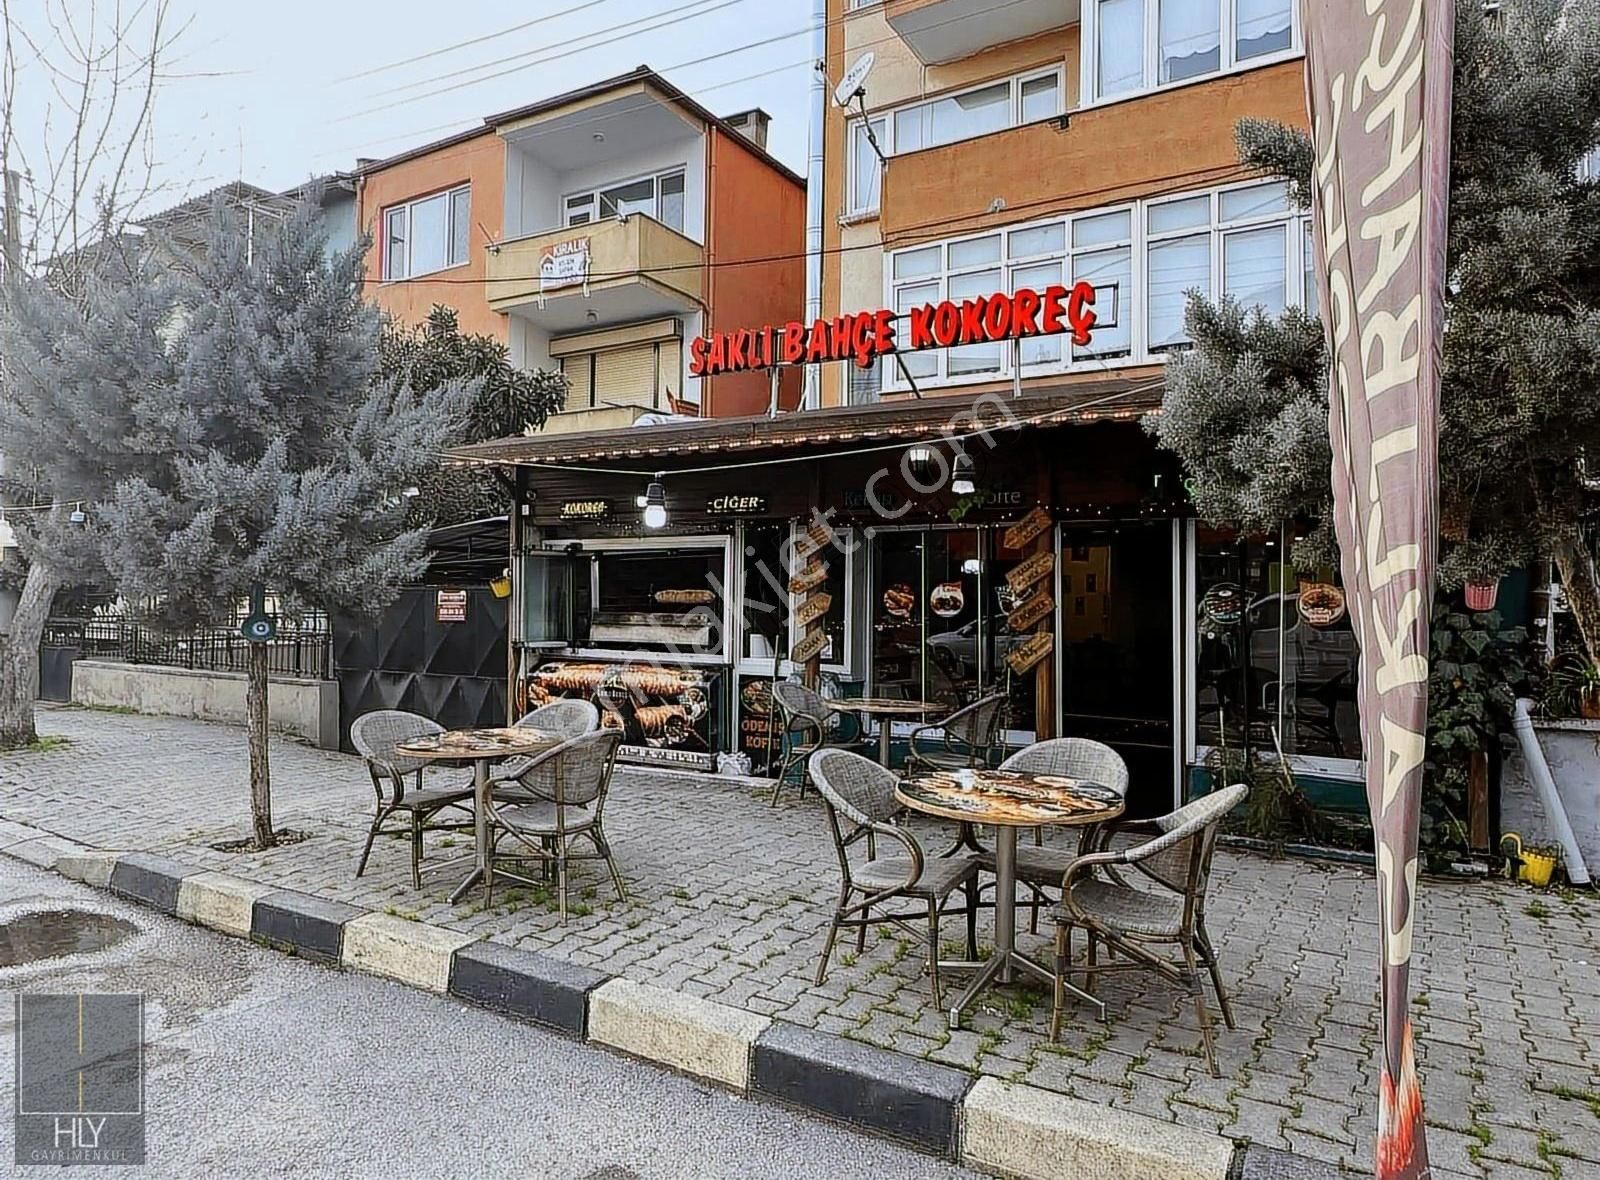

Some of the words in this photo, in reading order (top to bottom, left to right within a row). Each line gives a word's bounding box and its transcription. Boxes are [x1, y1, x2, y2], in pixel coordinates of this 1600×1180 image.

[690, 326, 773, 376] SAKLI
[783, 309, 897, 368] BAHÇE
[910, 281, 1097, 346] KOKOREÇ
